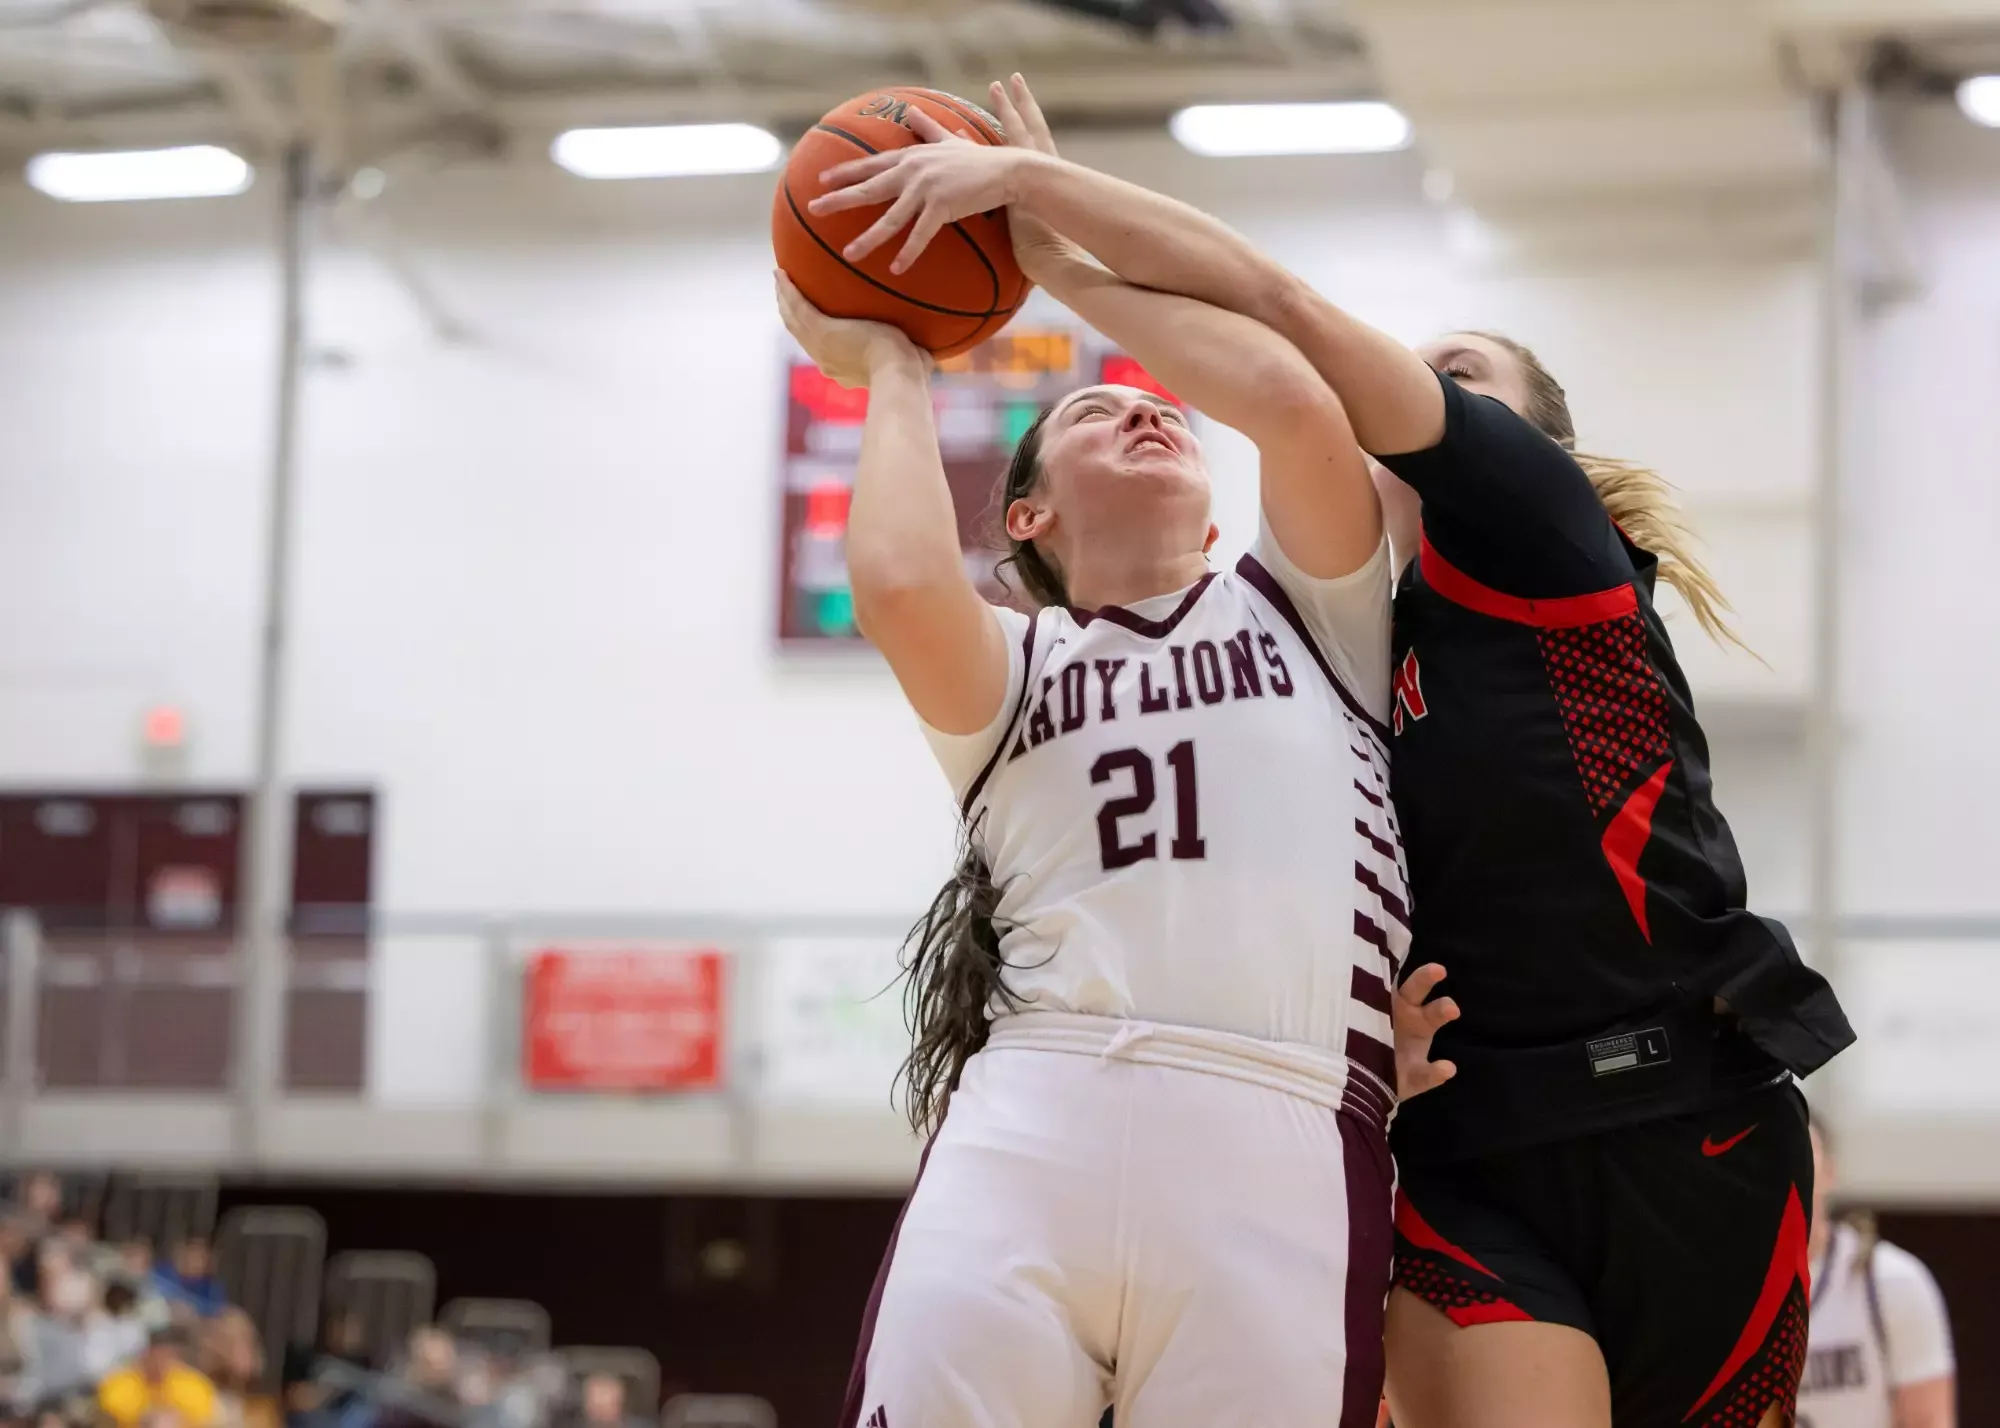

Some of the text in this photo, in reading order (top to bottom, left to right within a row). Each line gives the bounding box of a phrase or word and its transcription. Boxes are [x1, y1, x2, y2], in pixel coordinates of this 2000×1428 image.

[1138, 627, 1295, 716] LIONS
[1088, 737, 1207, 874] 21
[1647, 1039, 1659, 1055] L
